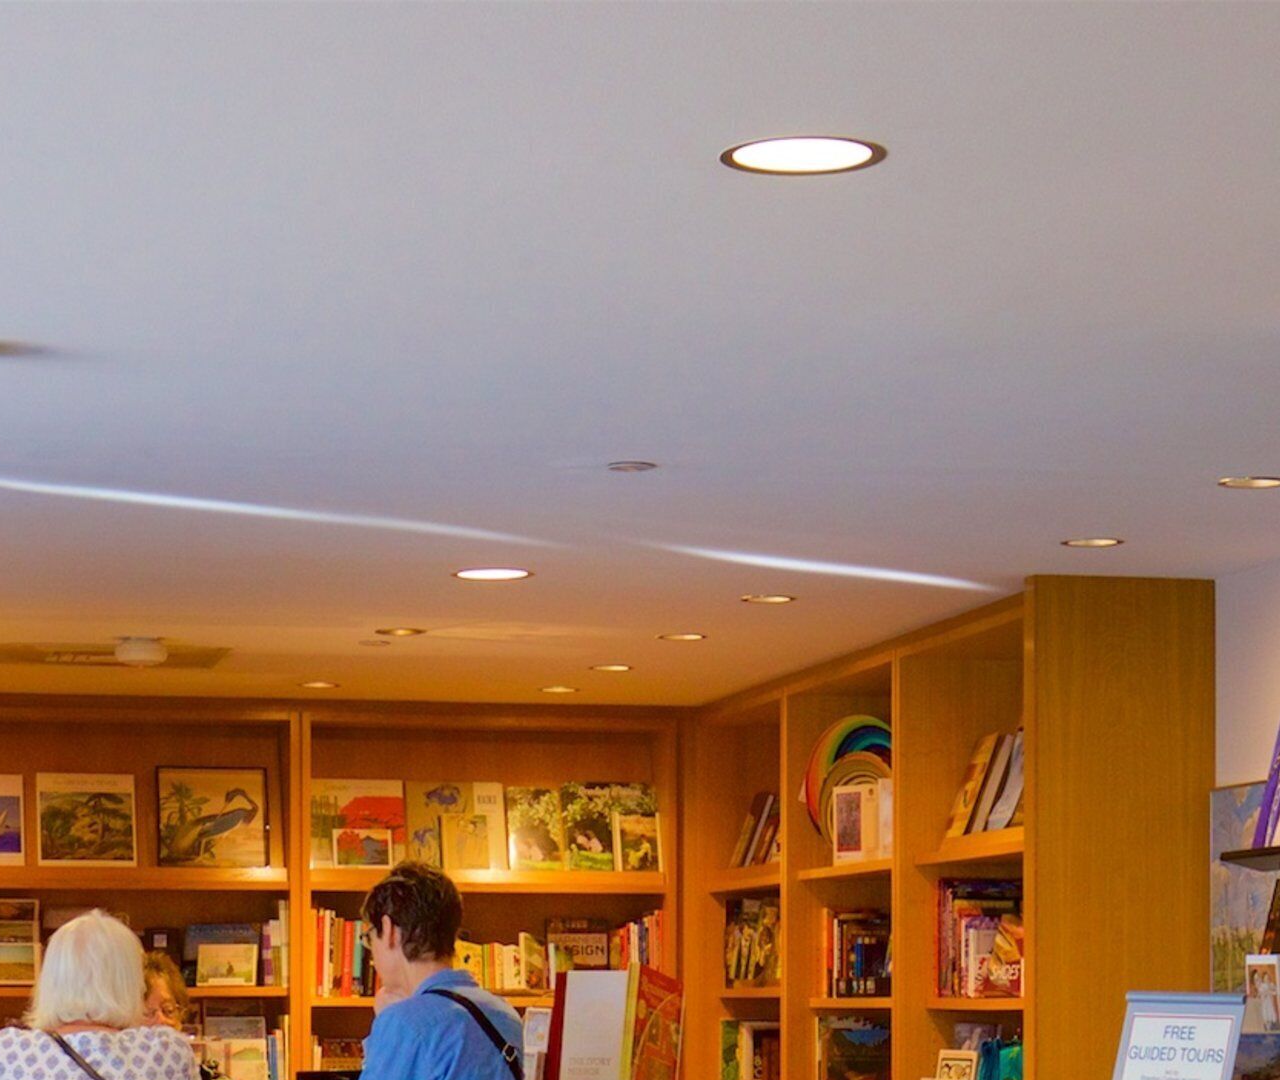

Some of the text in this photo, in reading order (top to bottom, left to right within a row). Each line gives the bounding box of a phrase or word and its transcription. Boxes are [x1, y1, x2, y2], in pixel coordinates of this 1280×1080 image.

[1163, 1025, 1196, 1040] FREE
[1128, 1045, 1225, 1064] GUIDED TOURS
